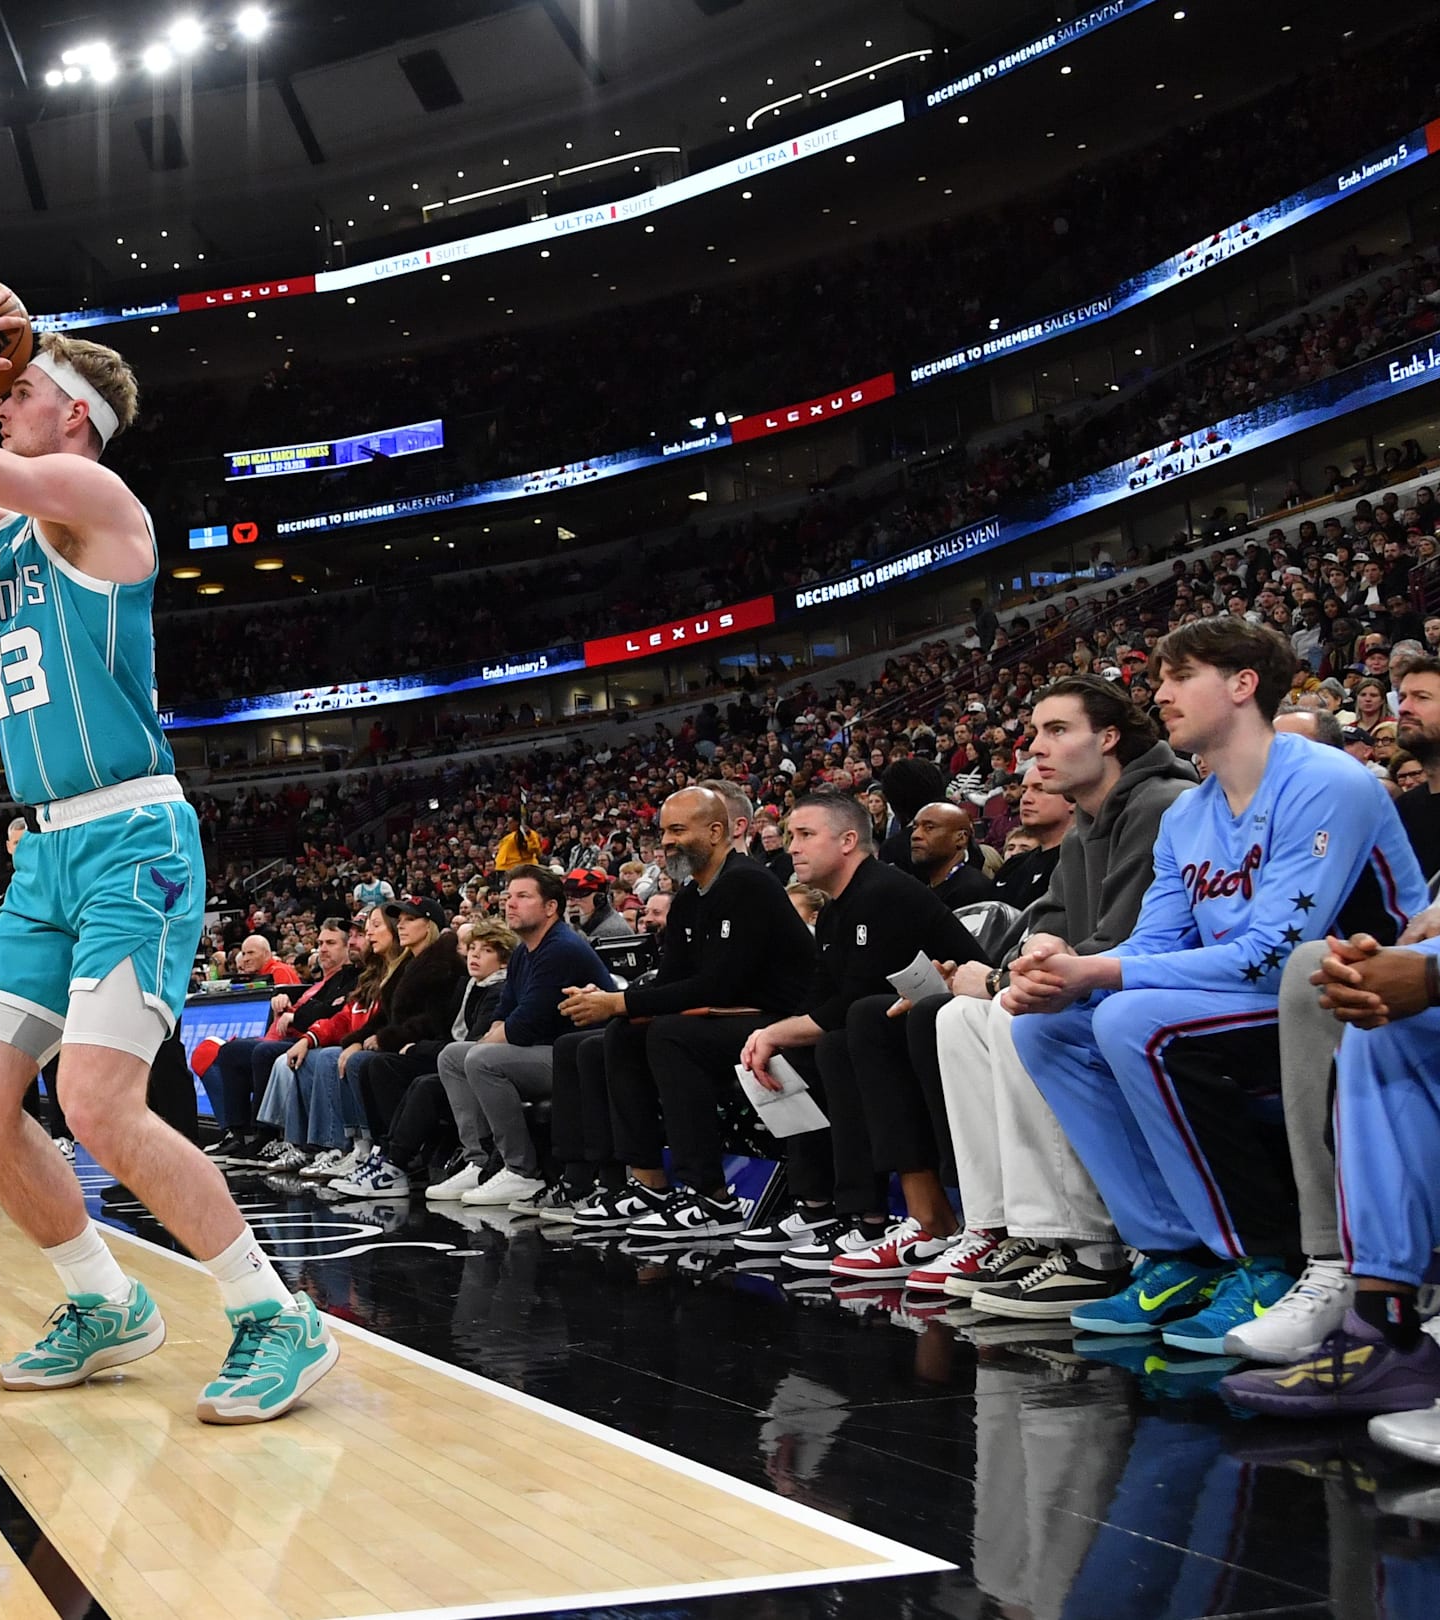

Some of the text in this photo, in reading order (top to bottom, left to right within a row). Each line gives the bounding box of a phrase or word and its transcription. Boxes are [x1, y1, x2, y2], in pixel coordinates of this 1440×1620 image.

[927, 71, 982, 107] DECEMBER
[982, 64, 997, 80] TO
[998, 34, 1056, 72] REMEMBER
[737, 129, 840, 175] ULTRA SUITE
[1337, 144, 1408, 191] Ends January 5
[554, 196, 655, 232] ULTRA SUITE
[374, 244, 470, 276] ULTRA SUITE
[205, 283, 289, 304] LEXUS
[910, 297, 1113, 382] DECEMBER TO REMEMBER SALES EVENT
[1388, 354, 1426, 384] Ends
[765, 390, 863, 428] LEXUS
[277, 492, 455, 534] DECEMBER TO REMEMBER SALES EVENT
[795, 521, 1001, 609] DECEMBER TO REMEMBER SALES EVENT
[625, 613, 734, 652] LEXUS
[482, 656, 548, 681] Ends January 5
